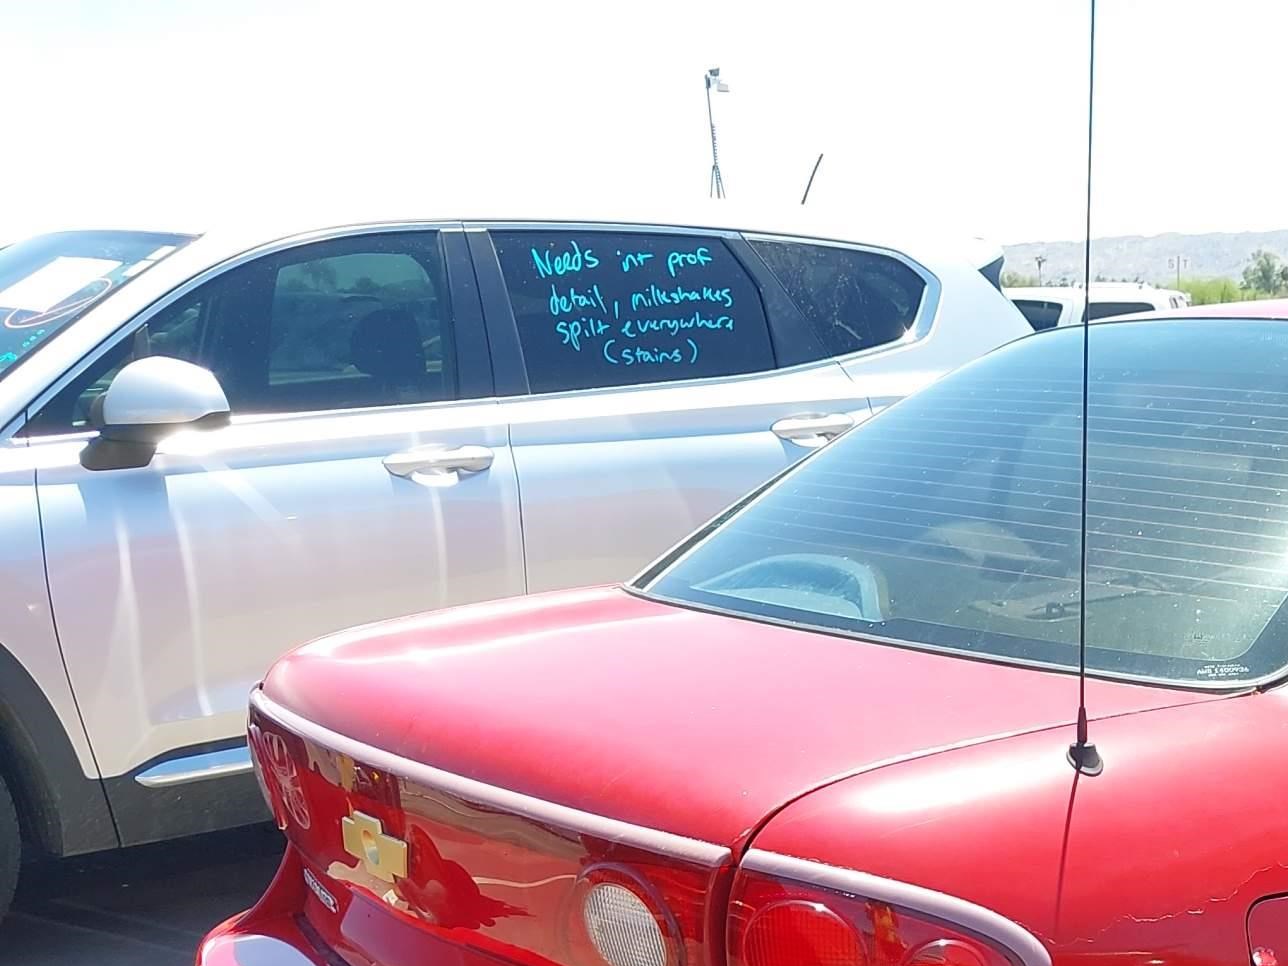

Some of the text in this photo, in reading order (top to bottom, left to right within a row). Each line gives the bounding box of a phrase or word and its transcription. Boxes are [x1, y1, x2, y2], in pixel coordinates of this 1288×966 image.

[531, 240, 599, 278] Needs
[667, 247, 712, 278] prof
[631, 285, 732, 311] milkshakes
[556, 318, 610, 351] spilt
[603, 338, 698, 365] (stains)
